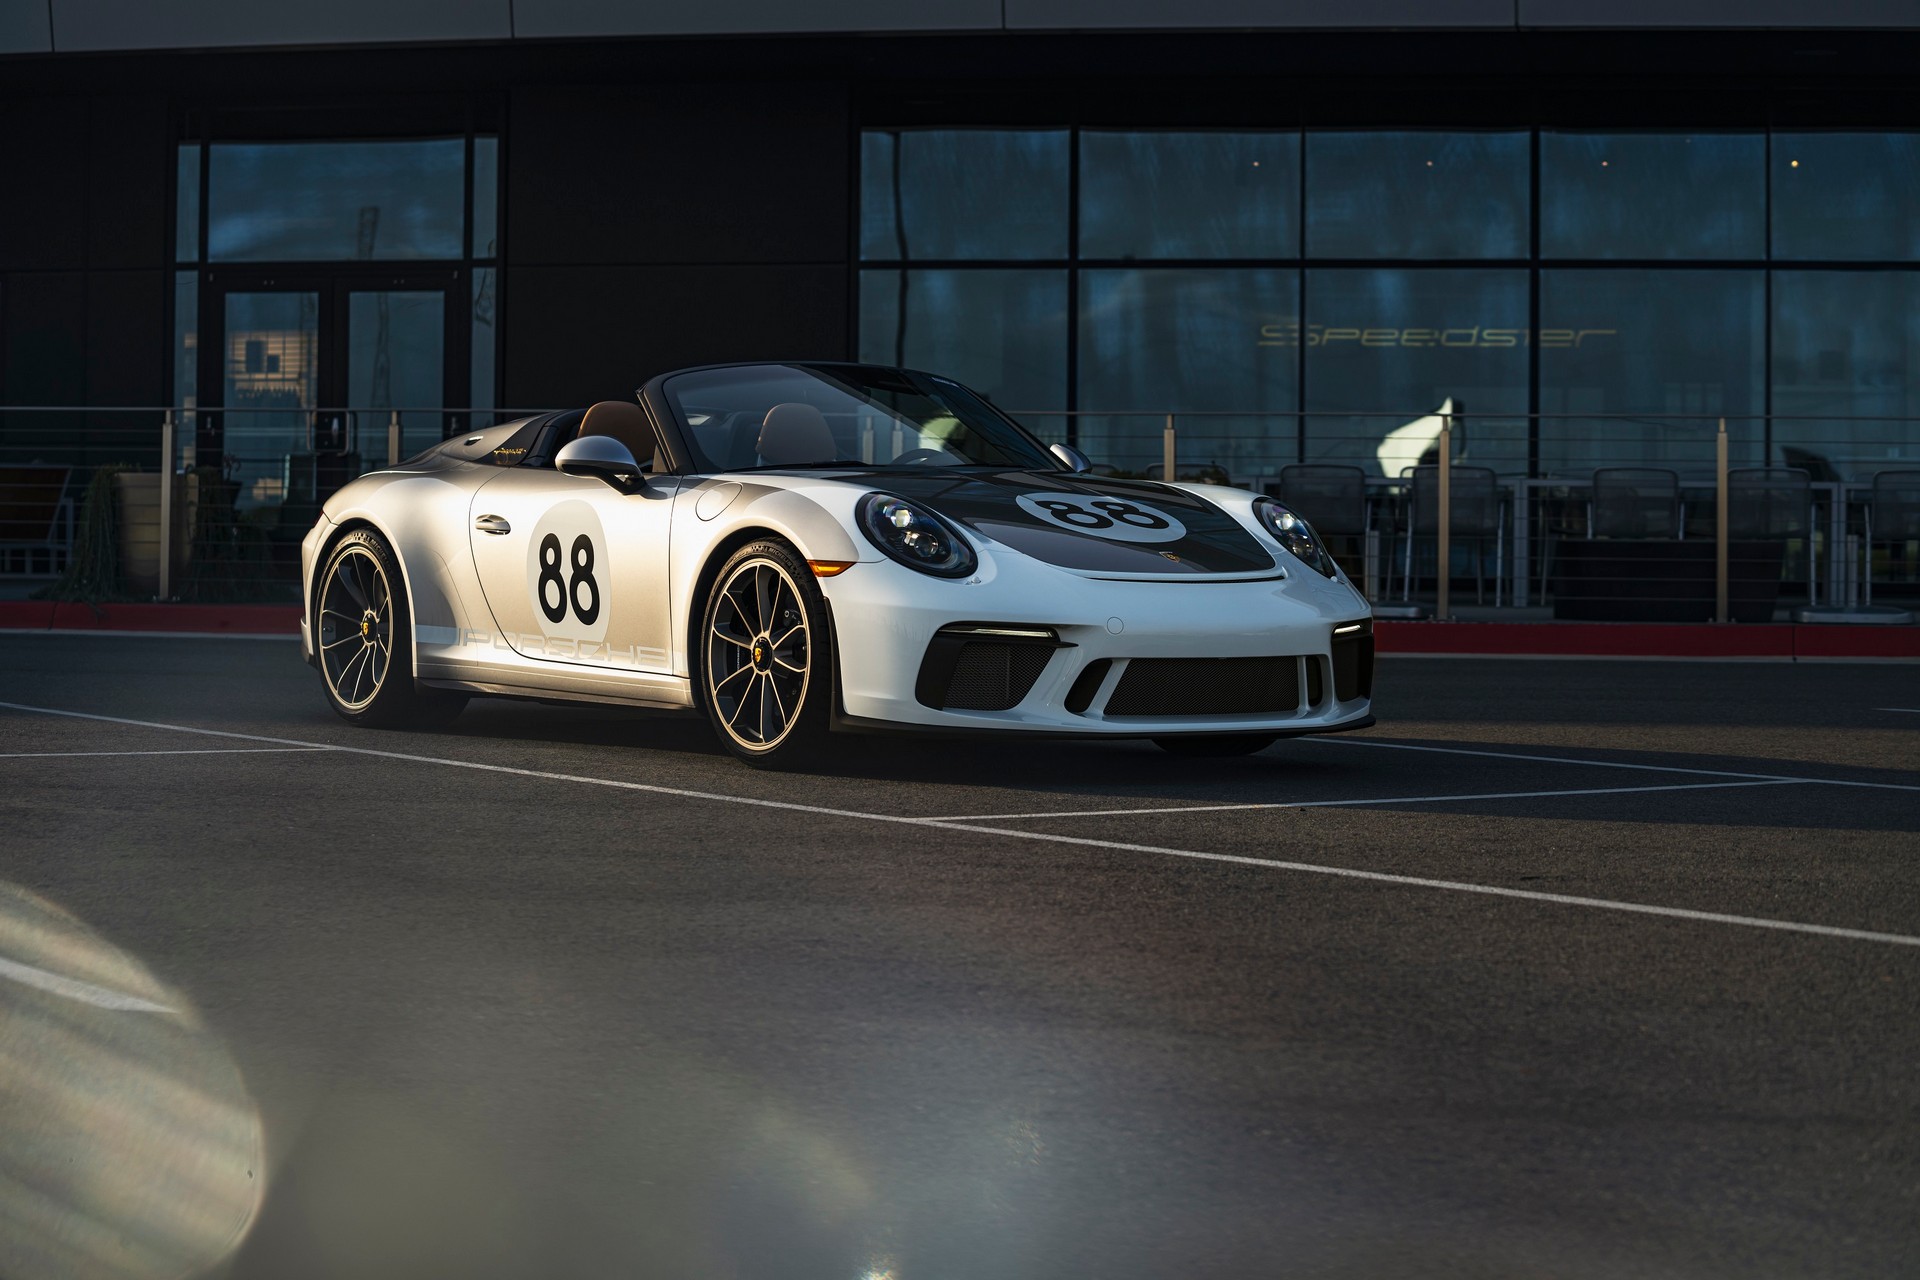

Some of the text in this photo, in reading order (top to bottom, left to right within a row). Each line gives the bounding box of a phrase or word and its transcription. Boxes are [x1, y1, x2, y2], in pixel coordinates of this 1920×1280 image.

[1034, 500, 1170, 530] 88
[538, 533, 600, 626] 88
[464, 628, 669, 669] PORSCHE
